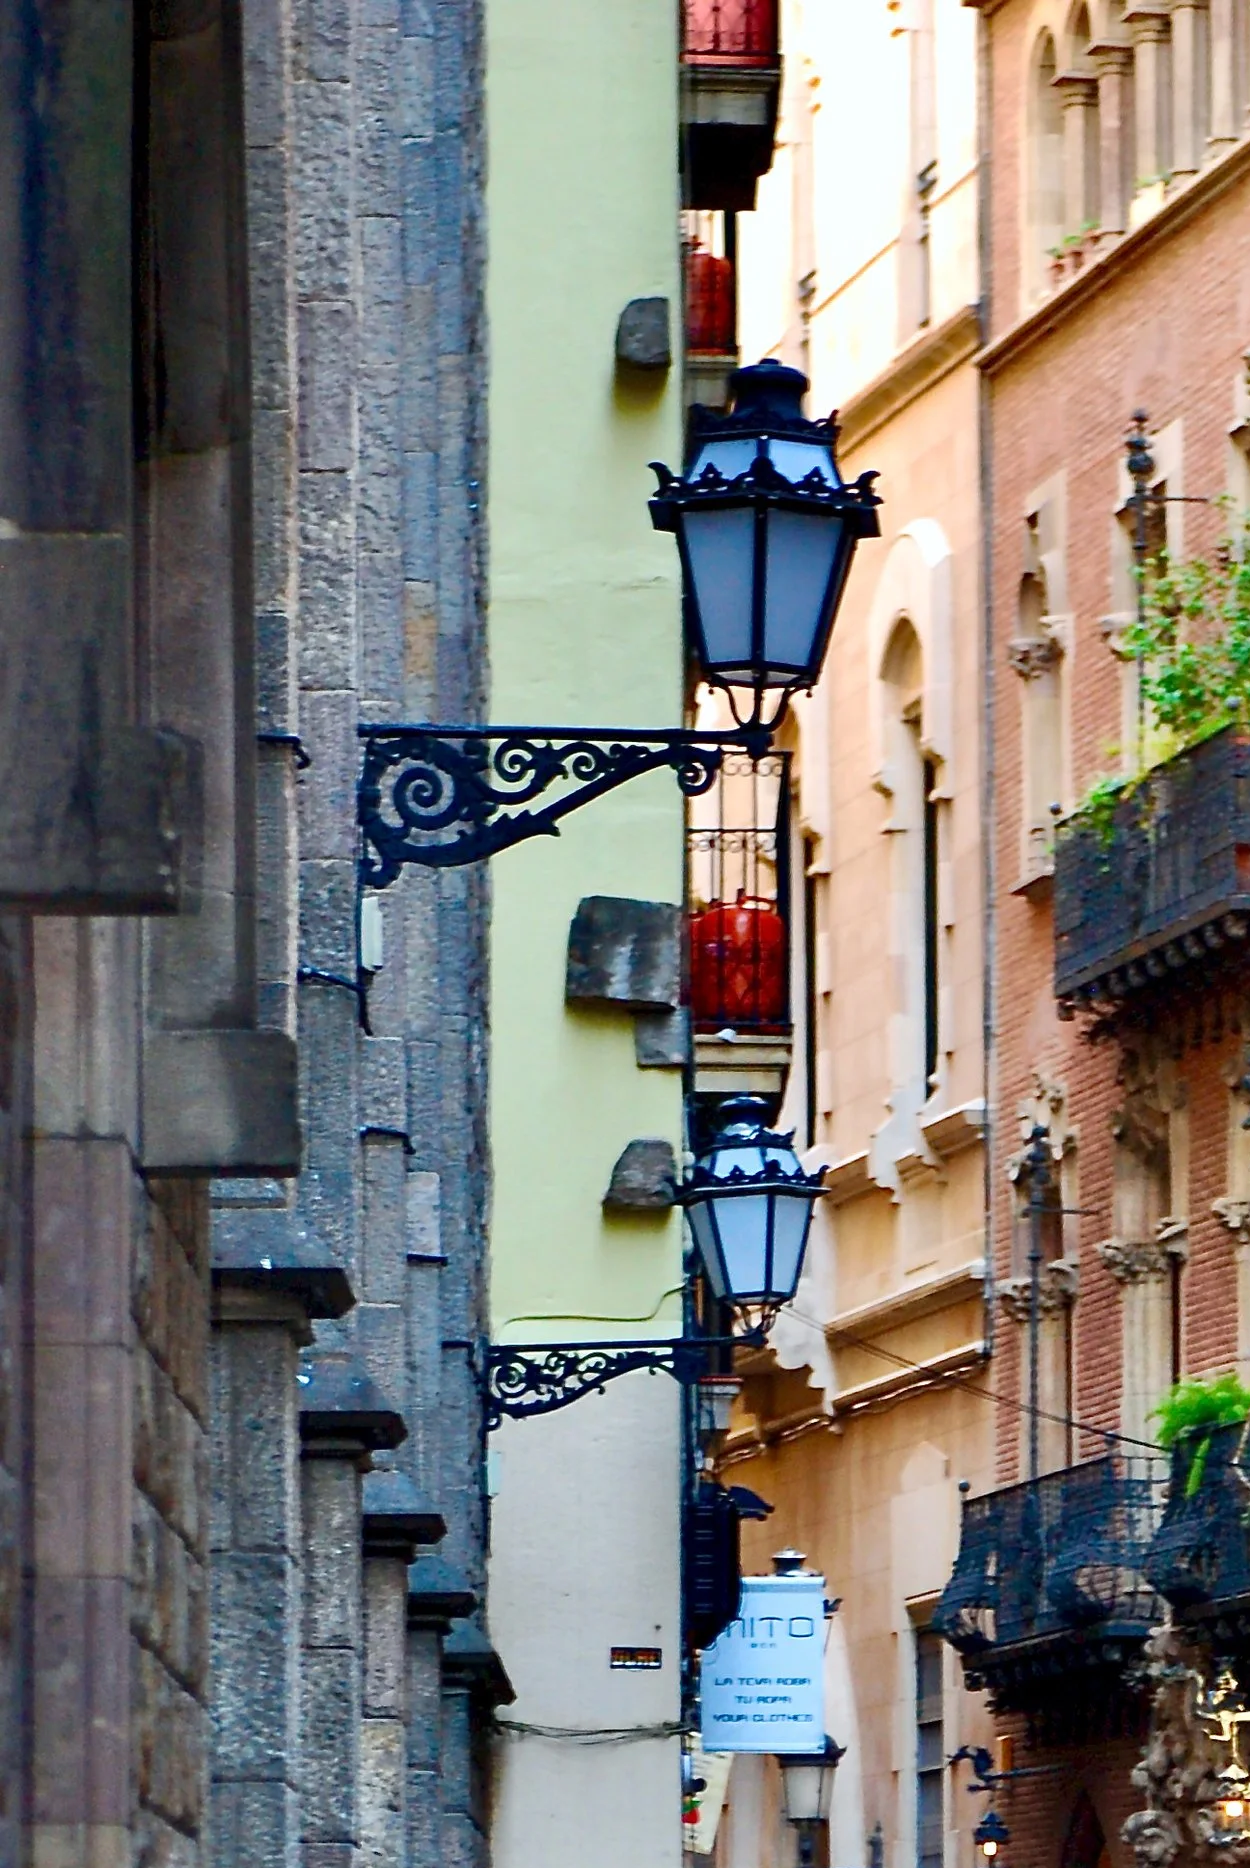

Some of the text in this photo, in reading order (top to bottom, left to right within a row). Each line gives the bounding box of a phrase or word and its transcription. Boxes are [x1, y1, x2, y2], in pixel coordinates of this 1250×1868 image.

[715, 1677, 733, 1686] LA
[737, 1677, 771, 1686] TEVA
[735, 1695, 752, 1704] TU
[713, 1713, 814, 1722] YOUR CLOTHES
